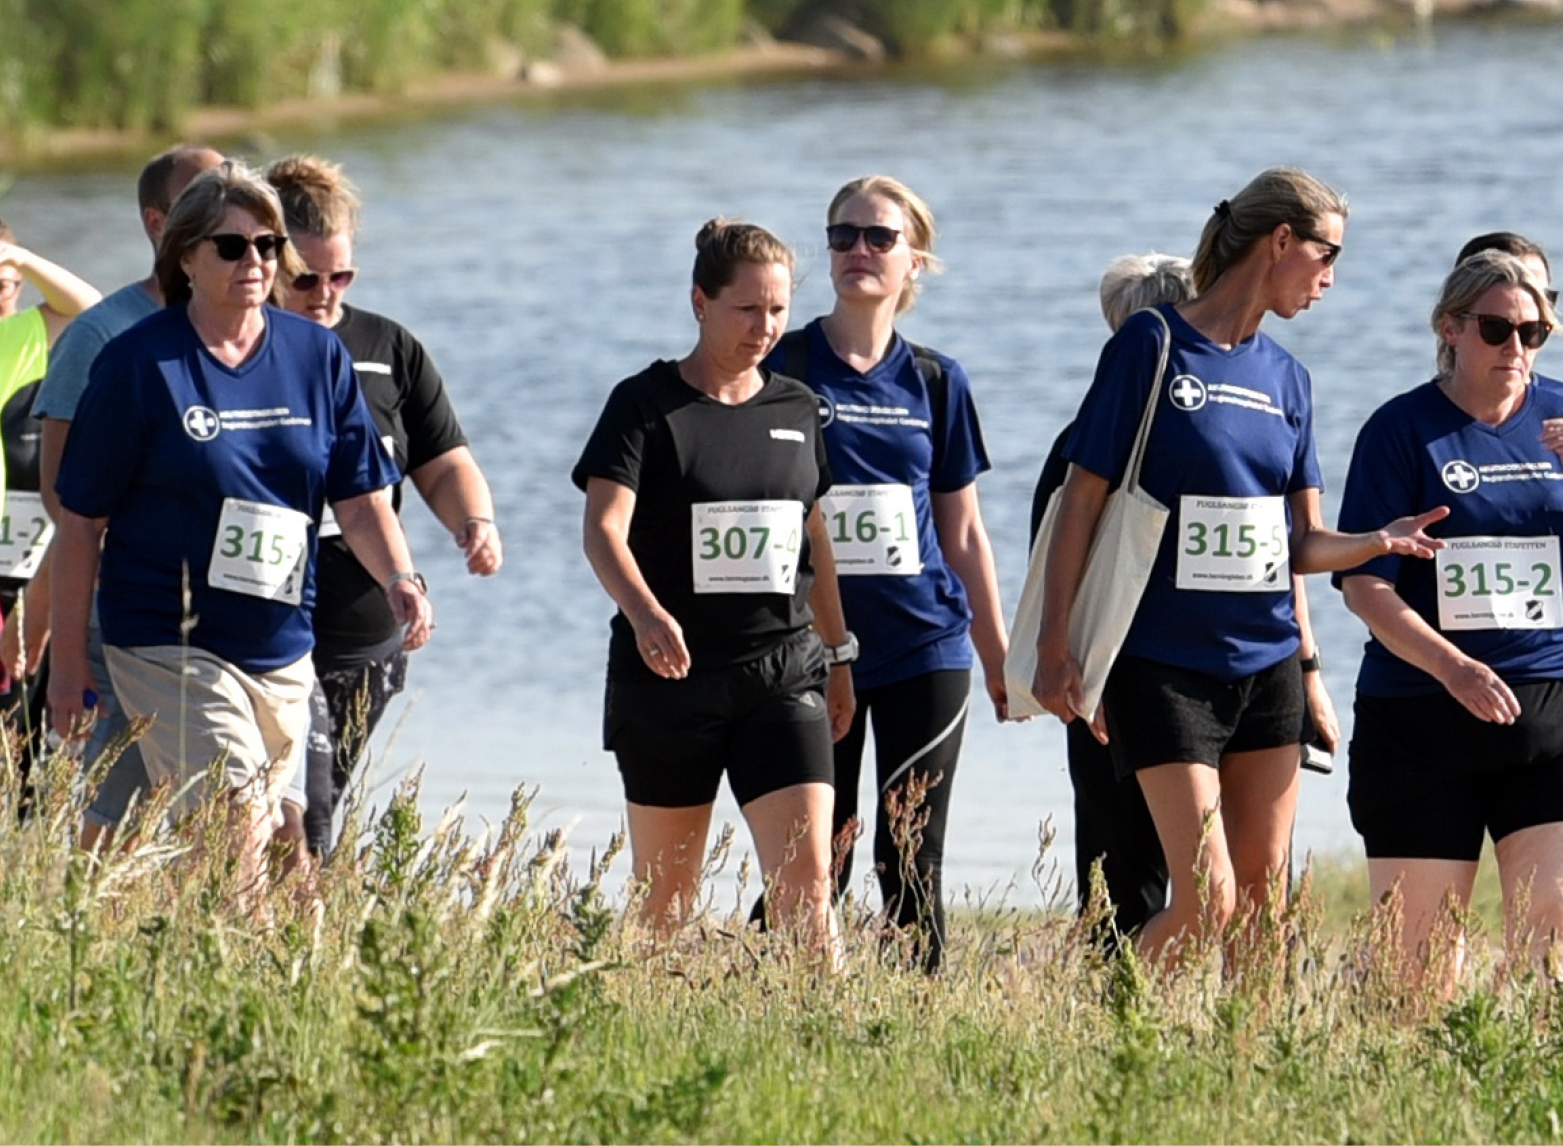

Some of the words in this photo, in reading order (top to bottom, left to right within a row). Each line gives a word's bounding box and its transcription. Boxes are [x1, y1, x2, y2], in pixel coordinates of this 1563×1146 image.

[699, 527, 798, 560] 307-4
[822, 510, 910, 543] 16-1
[1185, 522, 1283, 558] 315-5
[1443, 562, 1555, 597] 315-2
